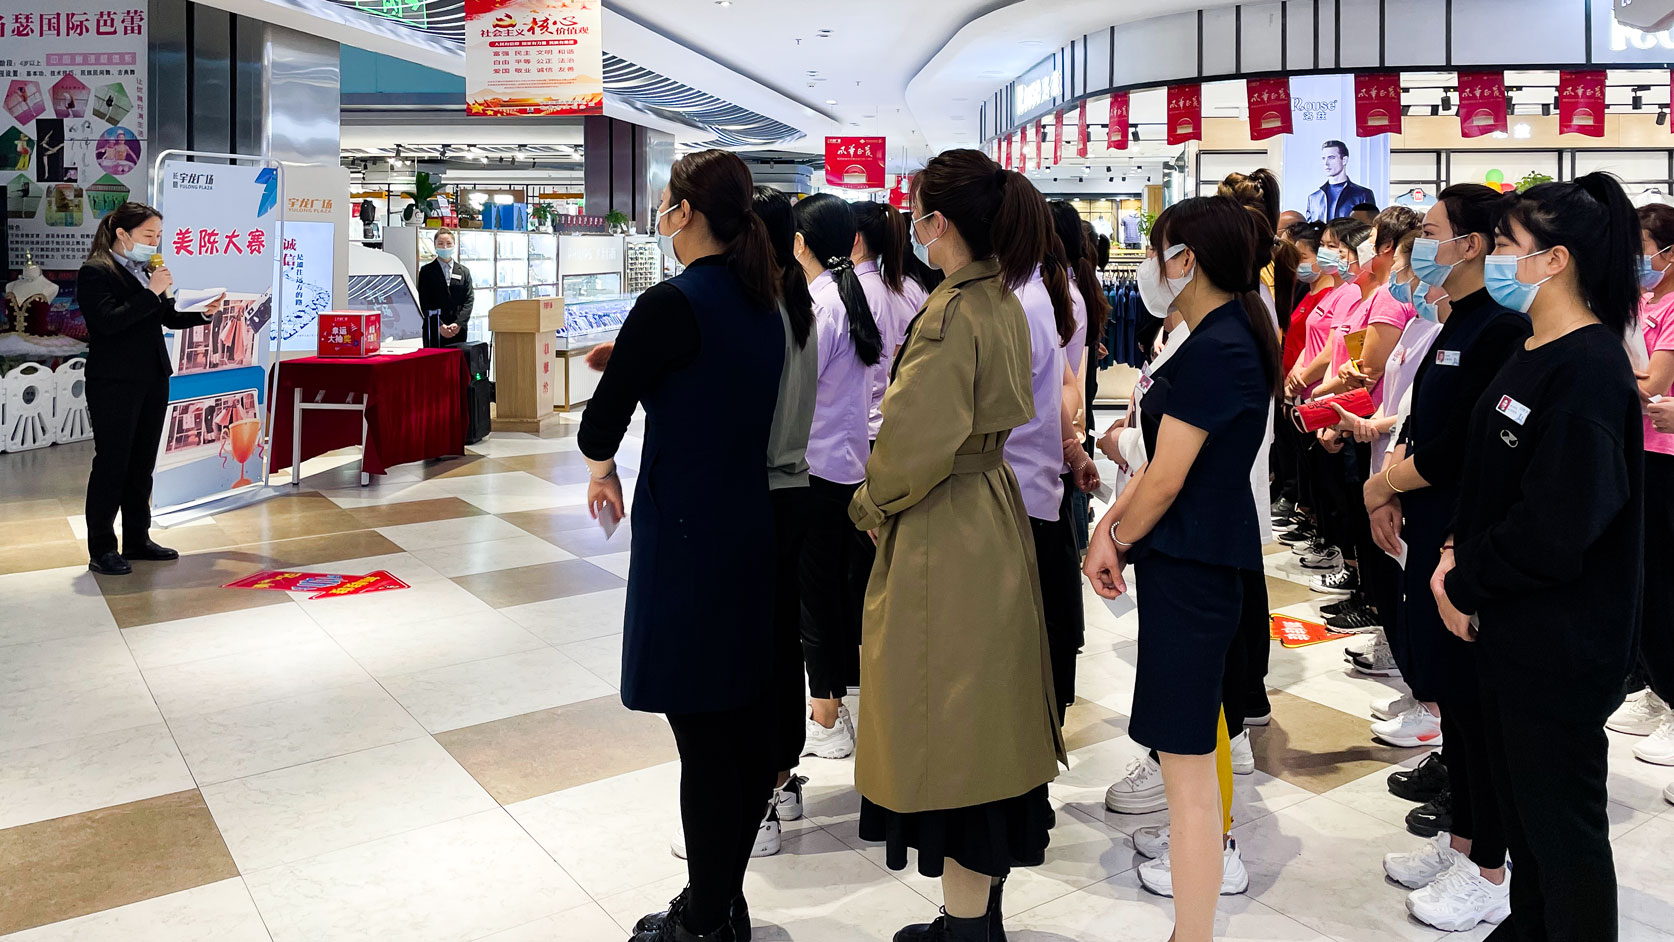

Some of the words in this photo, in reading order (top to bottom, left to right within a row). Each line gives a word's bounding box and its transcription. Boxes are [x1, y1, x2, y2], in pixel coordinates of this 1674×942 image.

[0, 10, 145, 37] 瑟国际芭蕾
[1291, 97, 1335, 111] Rouse
[180, 172, 214, 185] 宇龙广场
[288, 198, 333, 208] 宇龙广场
[172, 227, 266, 256] 美陈大赛
[283, 238, 297, 266] 诚信
[332, 326, 347, 335] 幸运
[328, 335, 352, 343] 大抽奖
